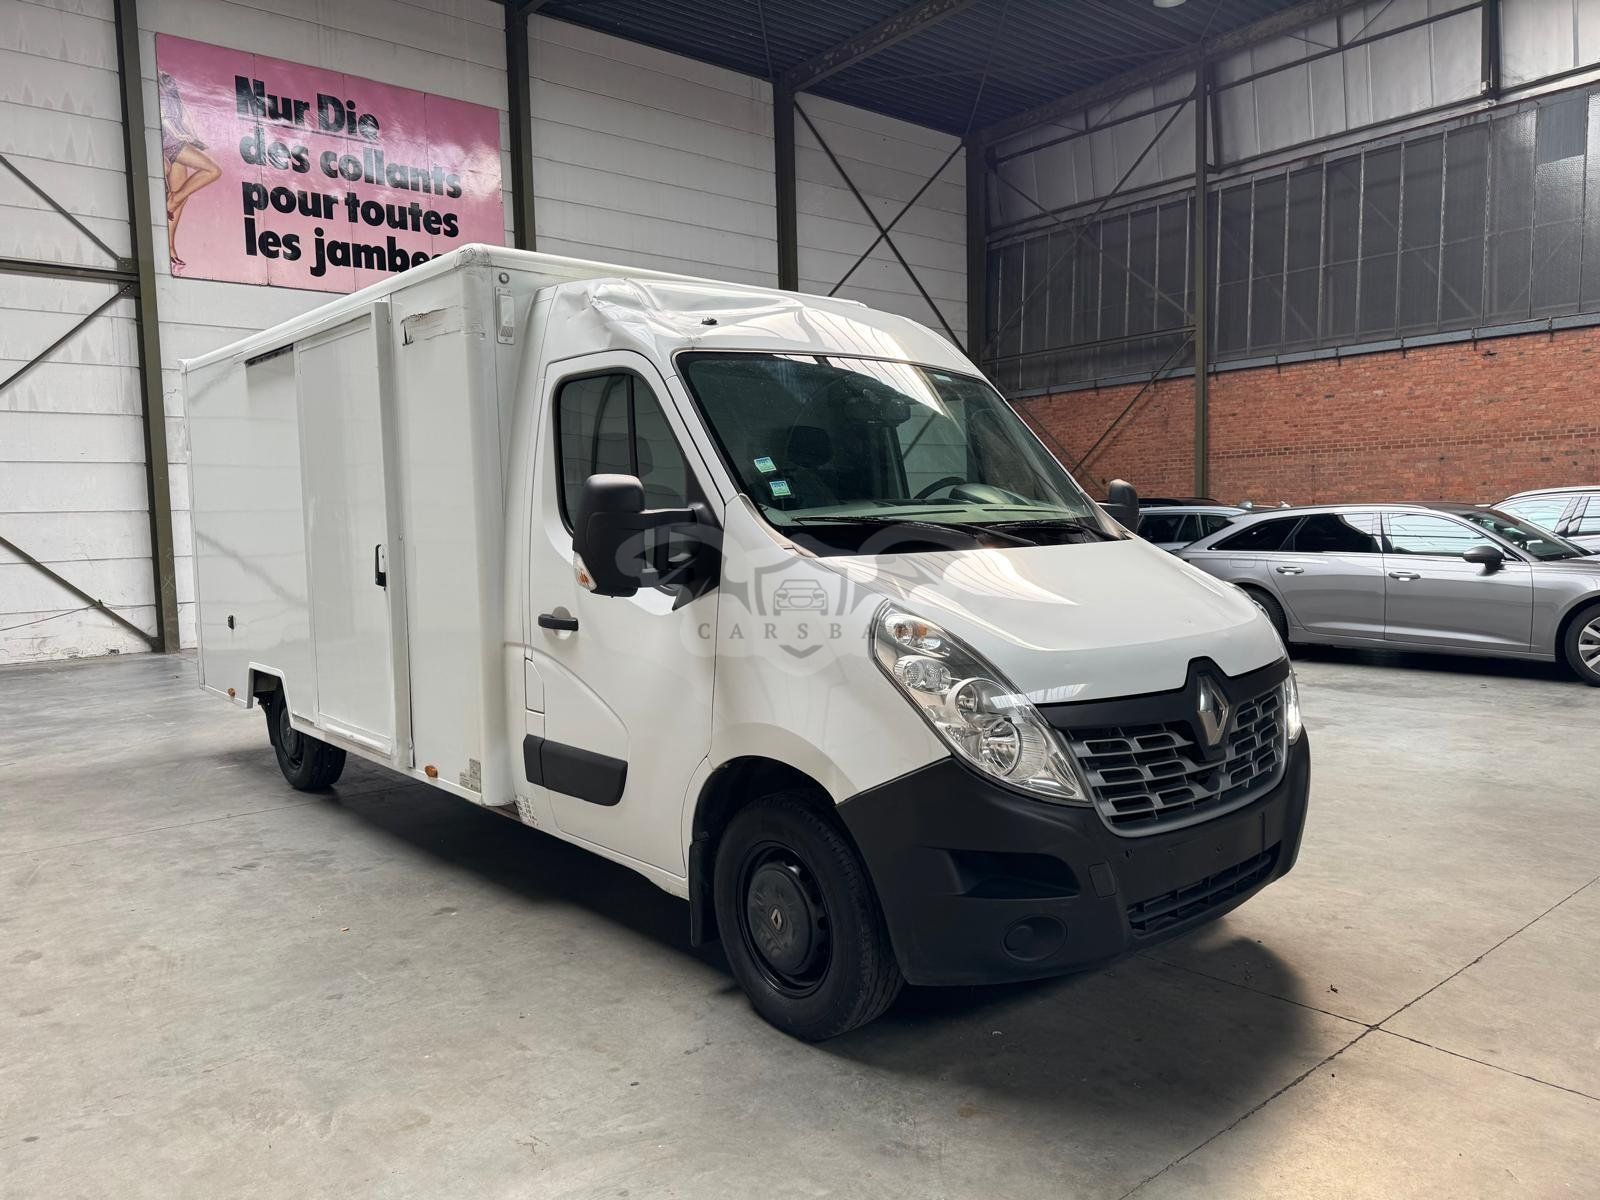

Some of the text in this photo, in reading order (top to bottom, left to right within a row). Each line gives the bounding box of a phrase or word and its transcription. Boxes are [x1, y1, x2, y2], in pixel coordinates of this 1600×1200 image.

[234, 75, 380, 141] Nur Die
[238, 123, 463, 199] des collants
[241, 181, 460, 238] pour toutes
[243, 216, 443, 277] les jambe
